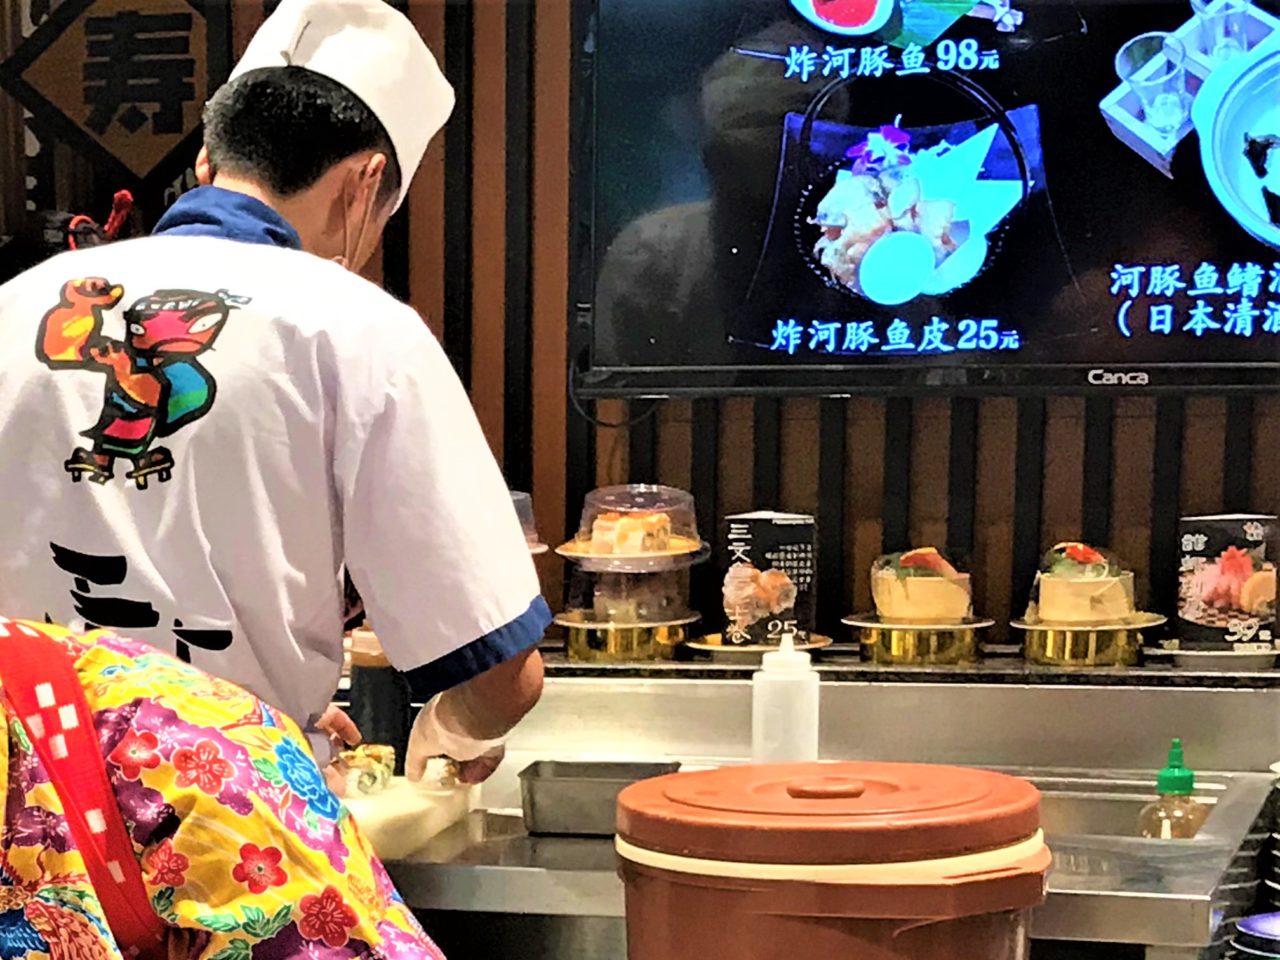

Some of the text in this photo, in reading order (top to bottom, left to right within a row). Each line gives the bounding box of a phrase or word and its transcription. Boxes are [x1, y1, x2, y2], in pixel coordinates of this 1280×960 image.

[83, 10, 196, 135] 寿
[784, 38, 1000, 82] 炸河豚鱼98元
[1110, 261, 1280, 298] 河豚鱼鳍
[770, 316, 1020, 354] 炸河豚鱼皮25元
[1087, 368, 1150, 386] Canca
